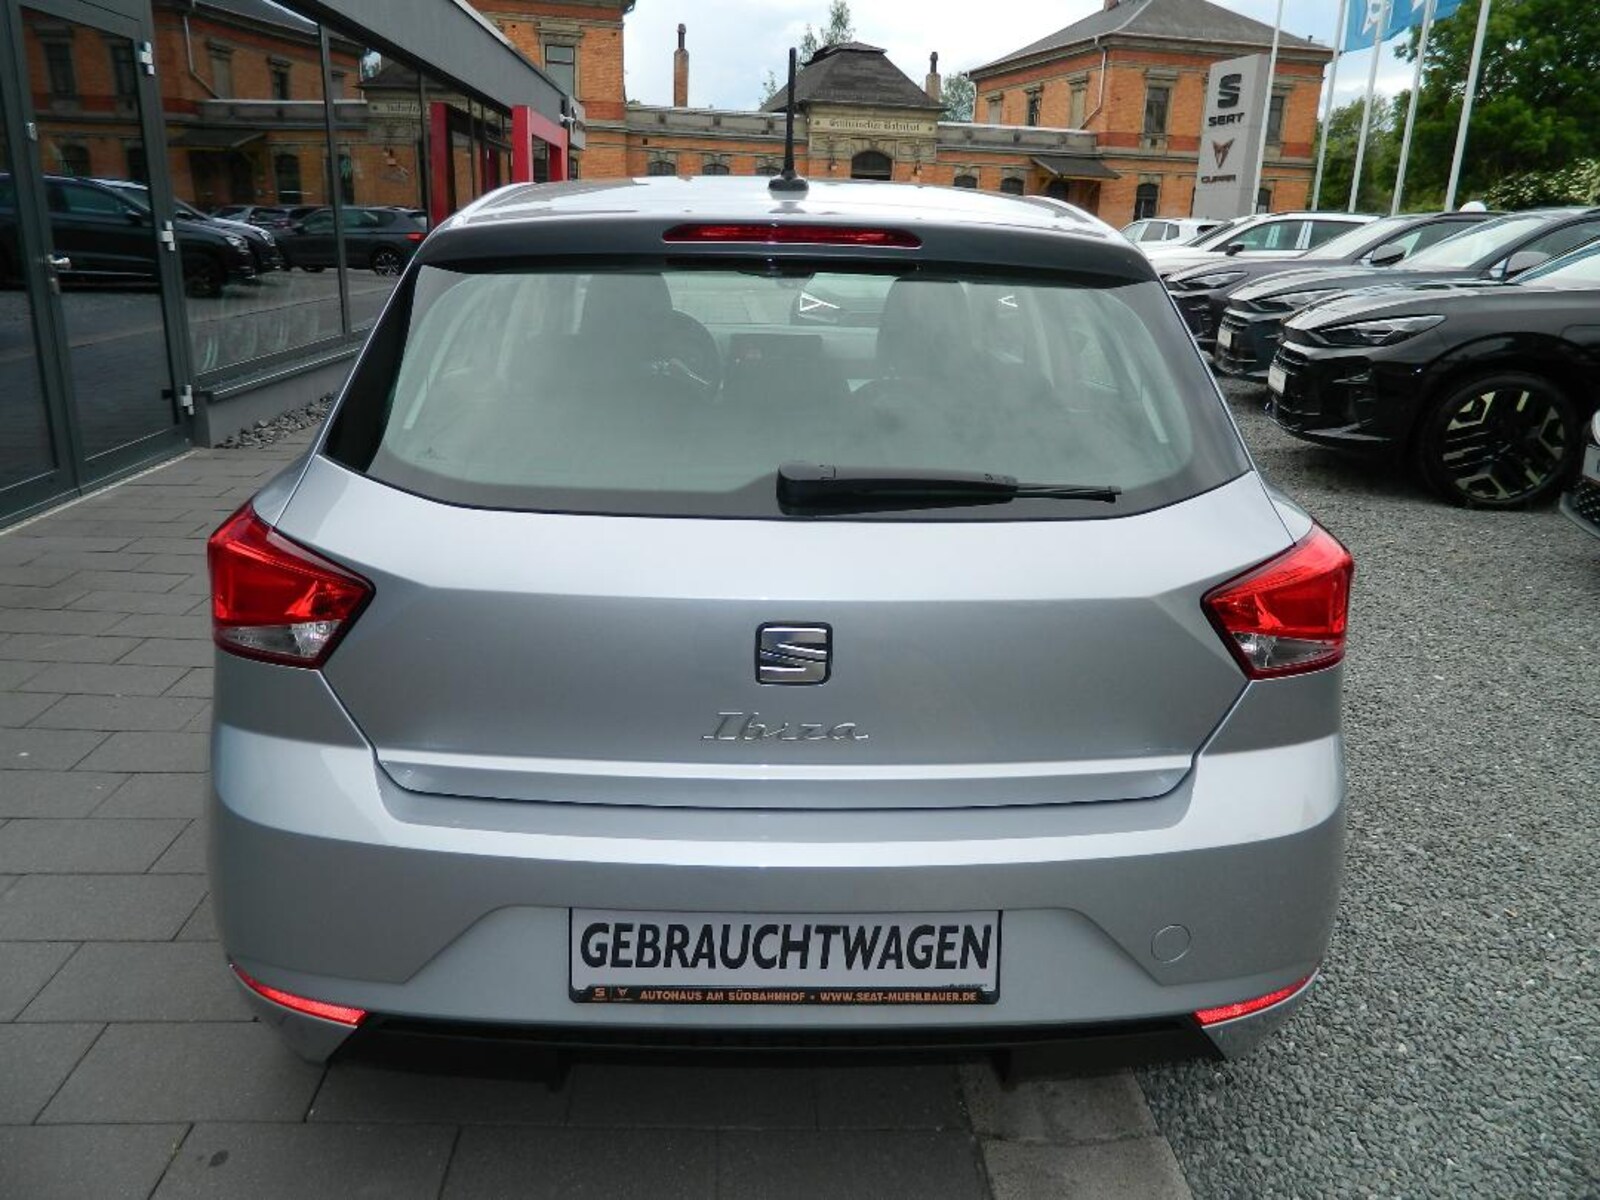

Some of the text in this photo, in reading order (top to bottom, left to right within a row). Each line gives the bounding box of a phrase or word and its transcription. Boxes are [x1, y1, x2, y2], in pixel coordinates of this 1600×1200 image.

[1208, 112, 1245, 127] SEAT
[701, 711, 870, 742] Ibiza
[580, 922, 993, 971] GEBRAUCHTWAGEN
[639, 990, 703, 1001] AUTOHAUS
[706, 991, 724, 1001] AM
[728, 989, 806, 1002] SÜDBAHNHOF
[820, 991, 977, 1002] WWW.SEAT-MUEHLBAUER.DE
